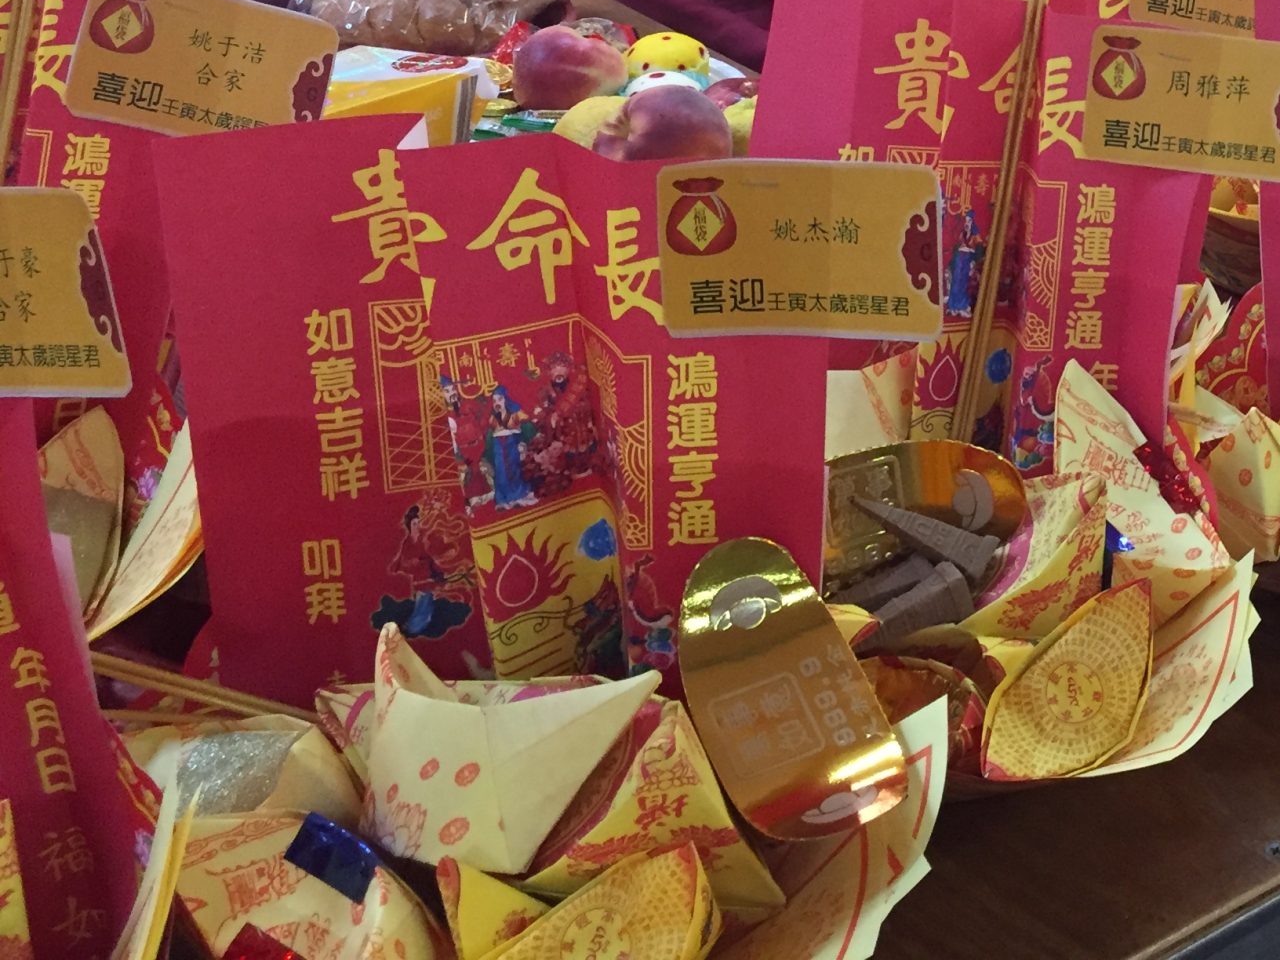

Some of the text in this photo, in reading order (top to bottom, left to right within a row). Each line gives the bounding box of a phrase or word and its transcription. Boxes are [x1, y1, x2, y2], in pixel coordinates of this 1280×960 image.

[195, 62, 246, 93] 合家
[769, 216, 862, 246] 姚杰瀚
[1064, 183, 1117, 351] 鴻運亨通
[304, 307, 370, 502] 如意吉祥
[666, 352, 719, 547] 鴻運亨通
[302, 539, 347, 625] 叩拜
[11, 646, 77, 794] 年月日
